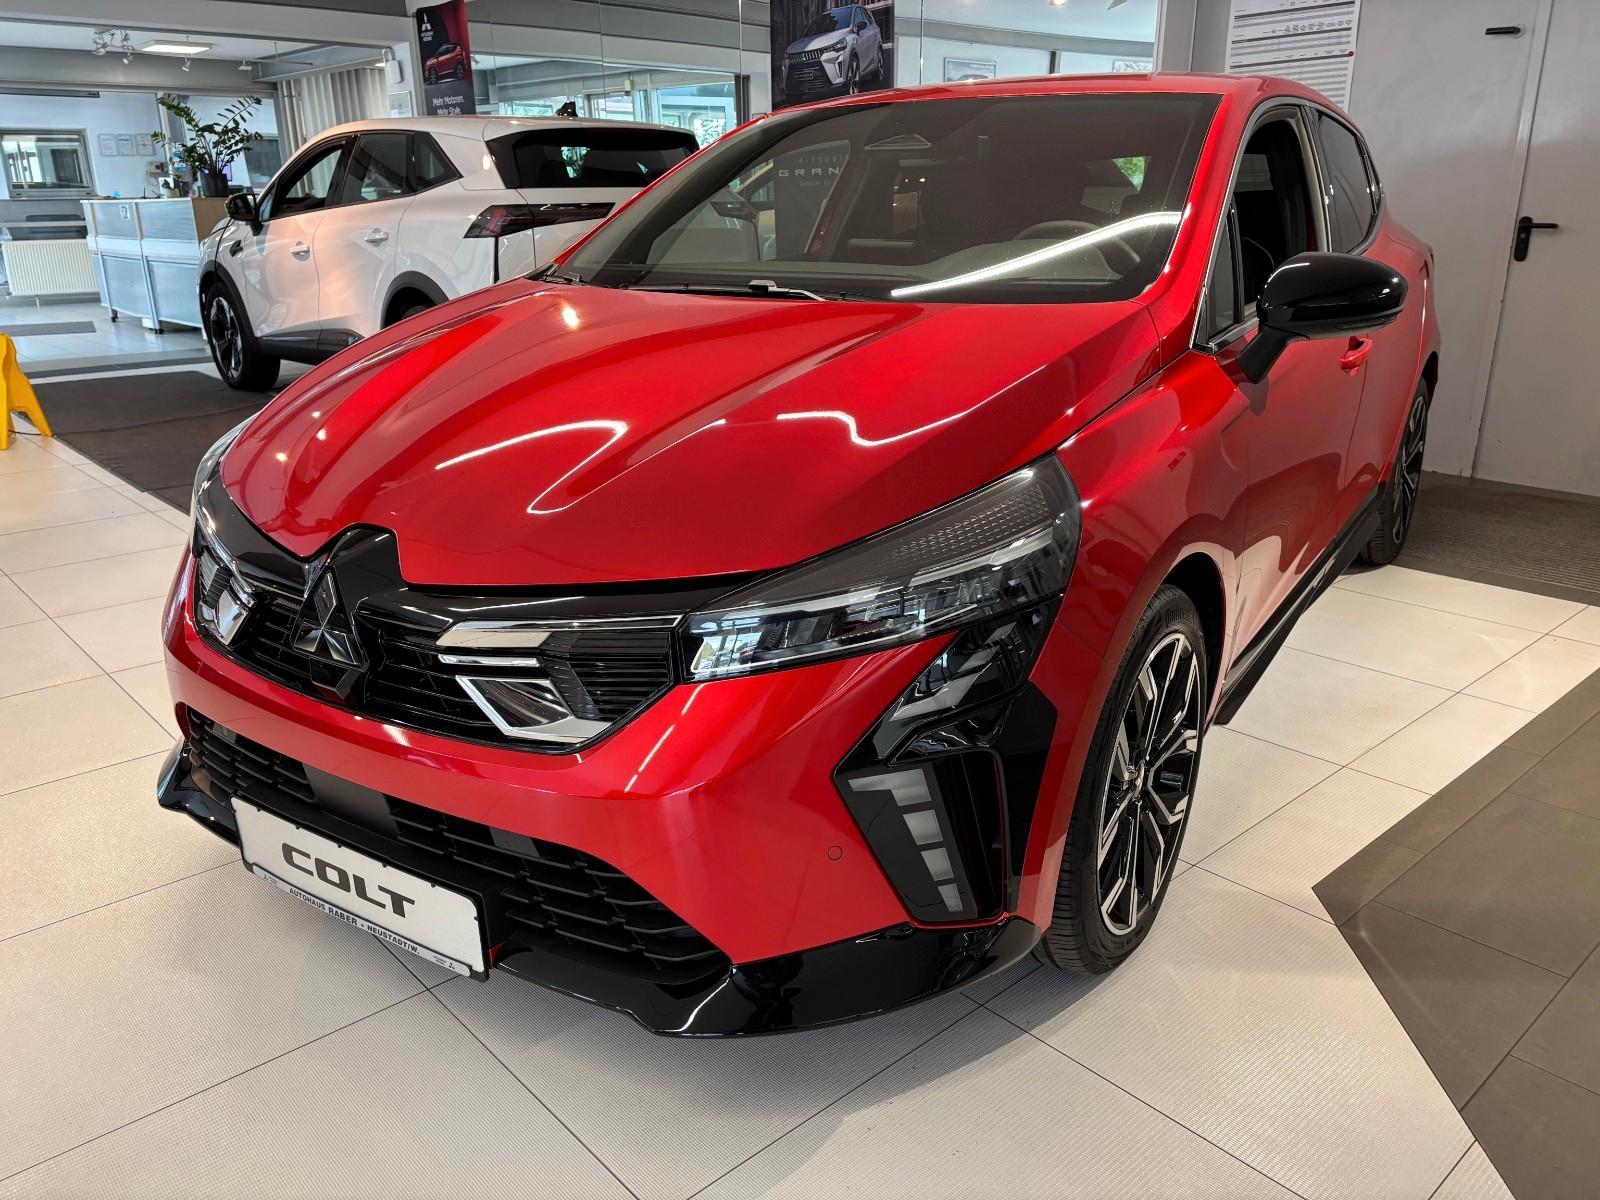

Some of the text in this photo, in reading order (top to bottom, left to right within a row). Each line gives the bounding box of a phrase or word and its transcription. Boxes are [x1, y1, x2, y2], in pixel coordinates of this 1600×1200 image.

[281, 842, 415, 918] COLT
[289, 887, 326, 911] AUTOHAUS
[328, 906, 357, 926] RABER
